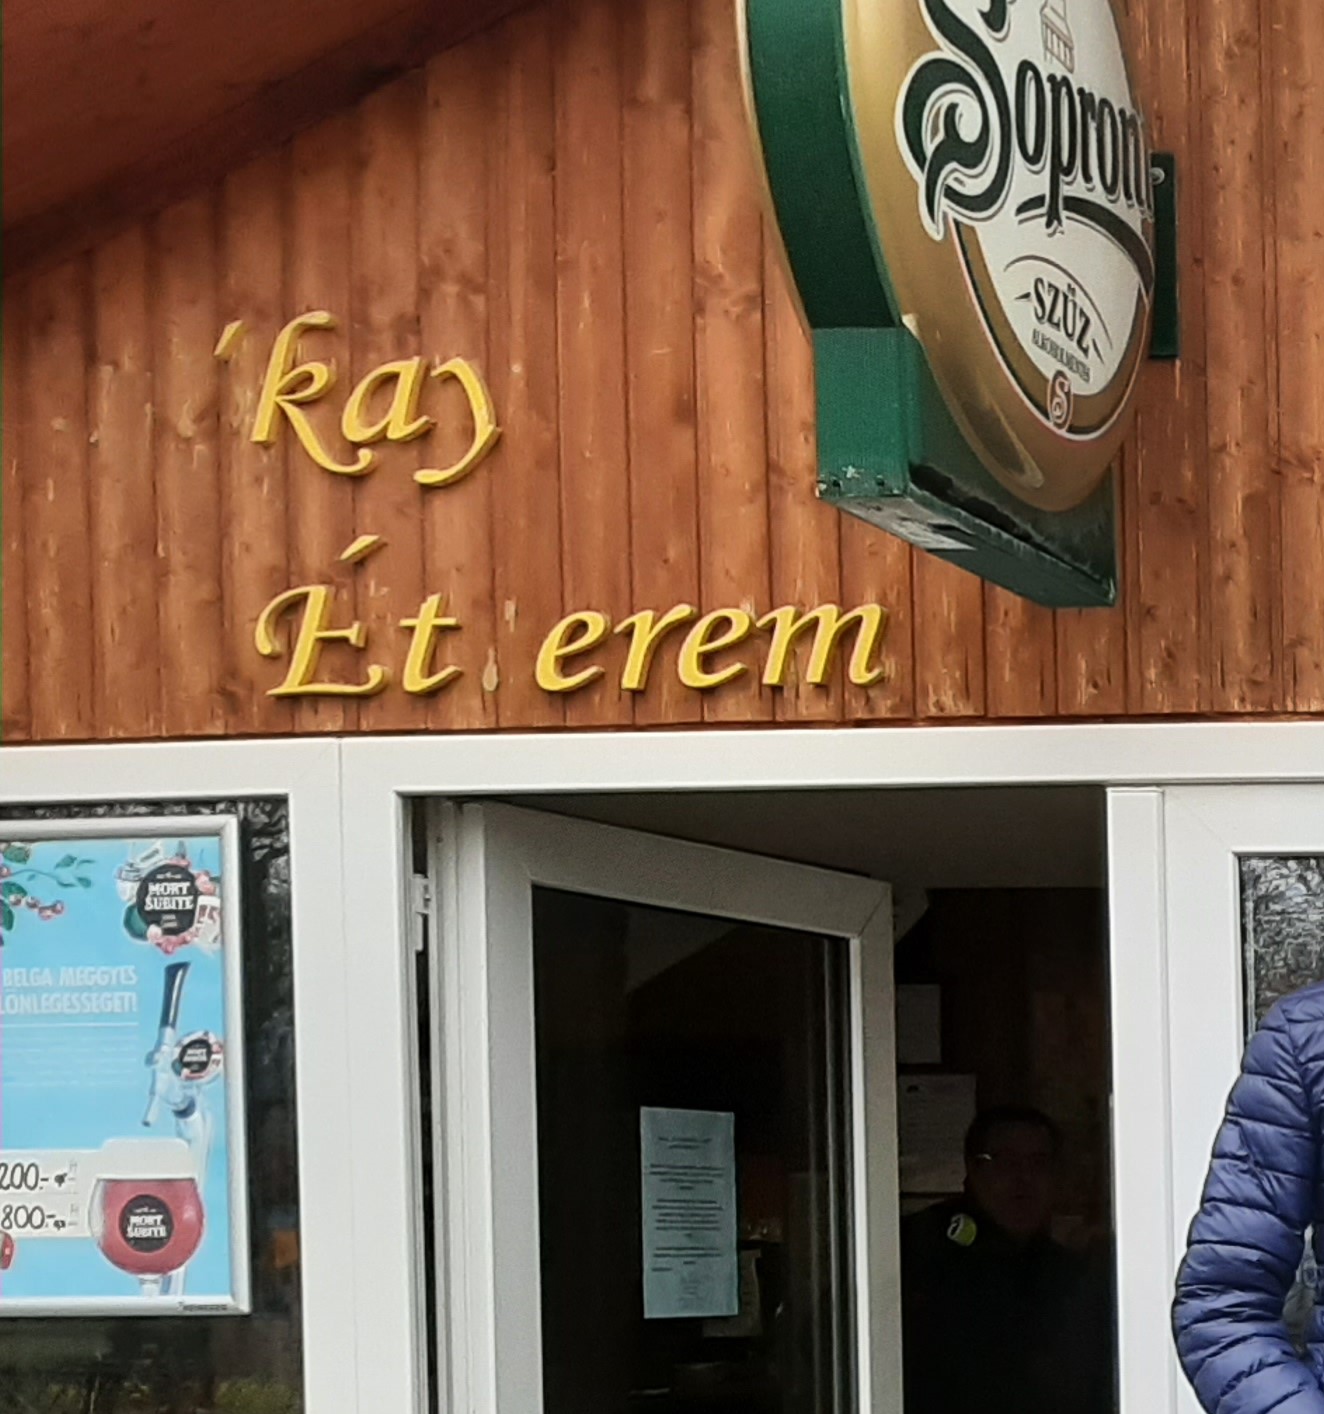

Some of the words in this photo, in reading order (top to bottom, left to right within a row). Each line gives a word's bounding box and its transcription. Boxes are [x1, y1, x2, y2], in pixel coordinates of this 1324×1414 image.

[148, 881, 191, 897] MORT
[144, 895, 194, 911] SUBITE
[3, 967, 53, 988] BELGA
[59, 965, 138, 987] MEGGYES
